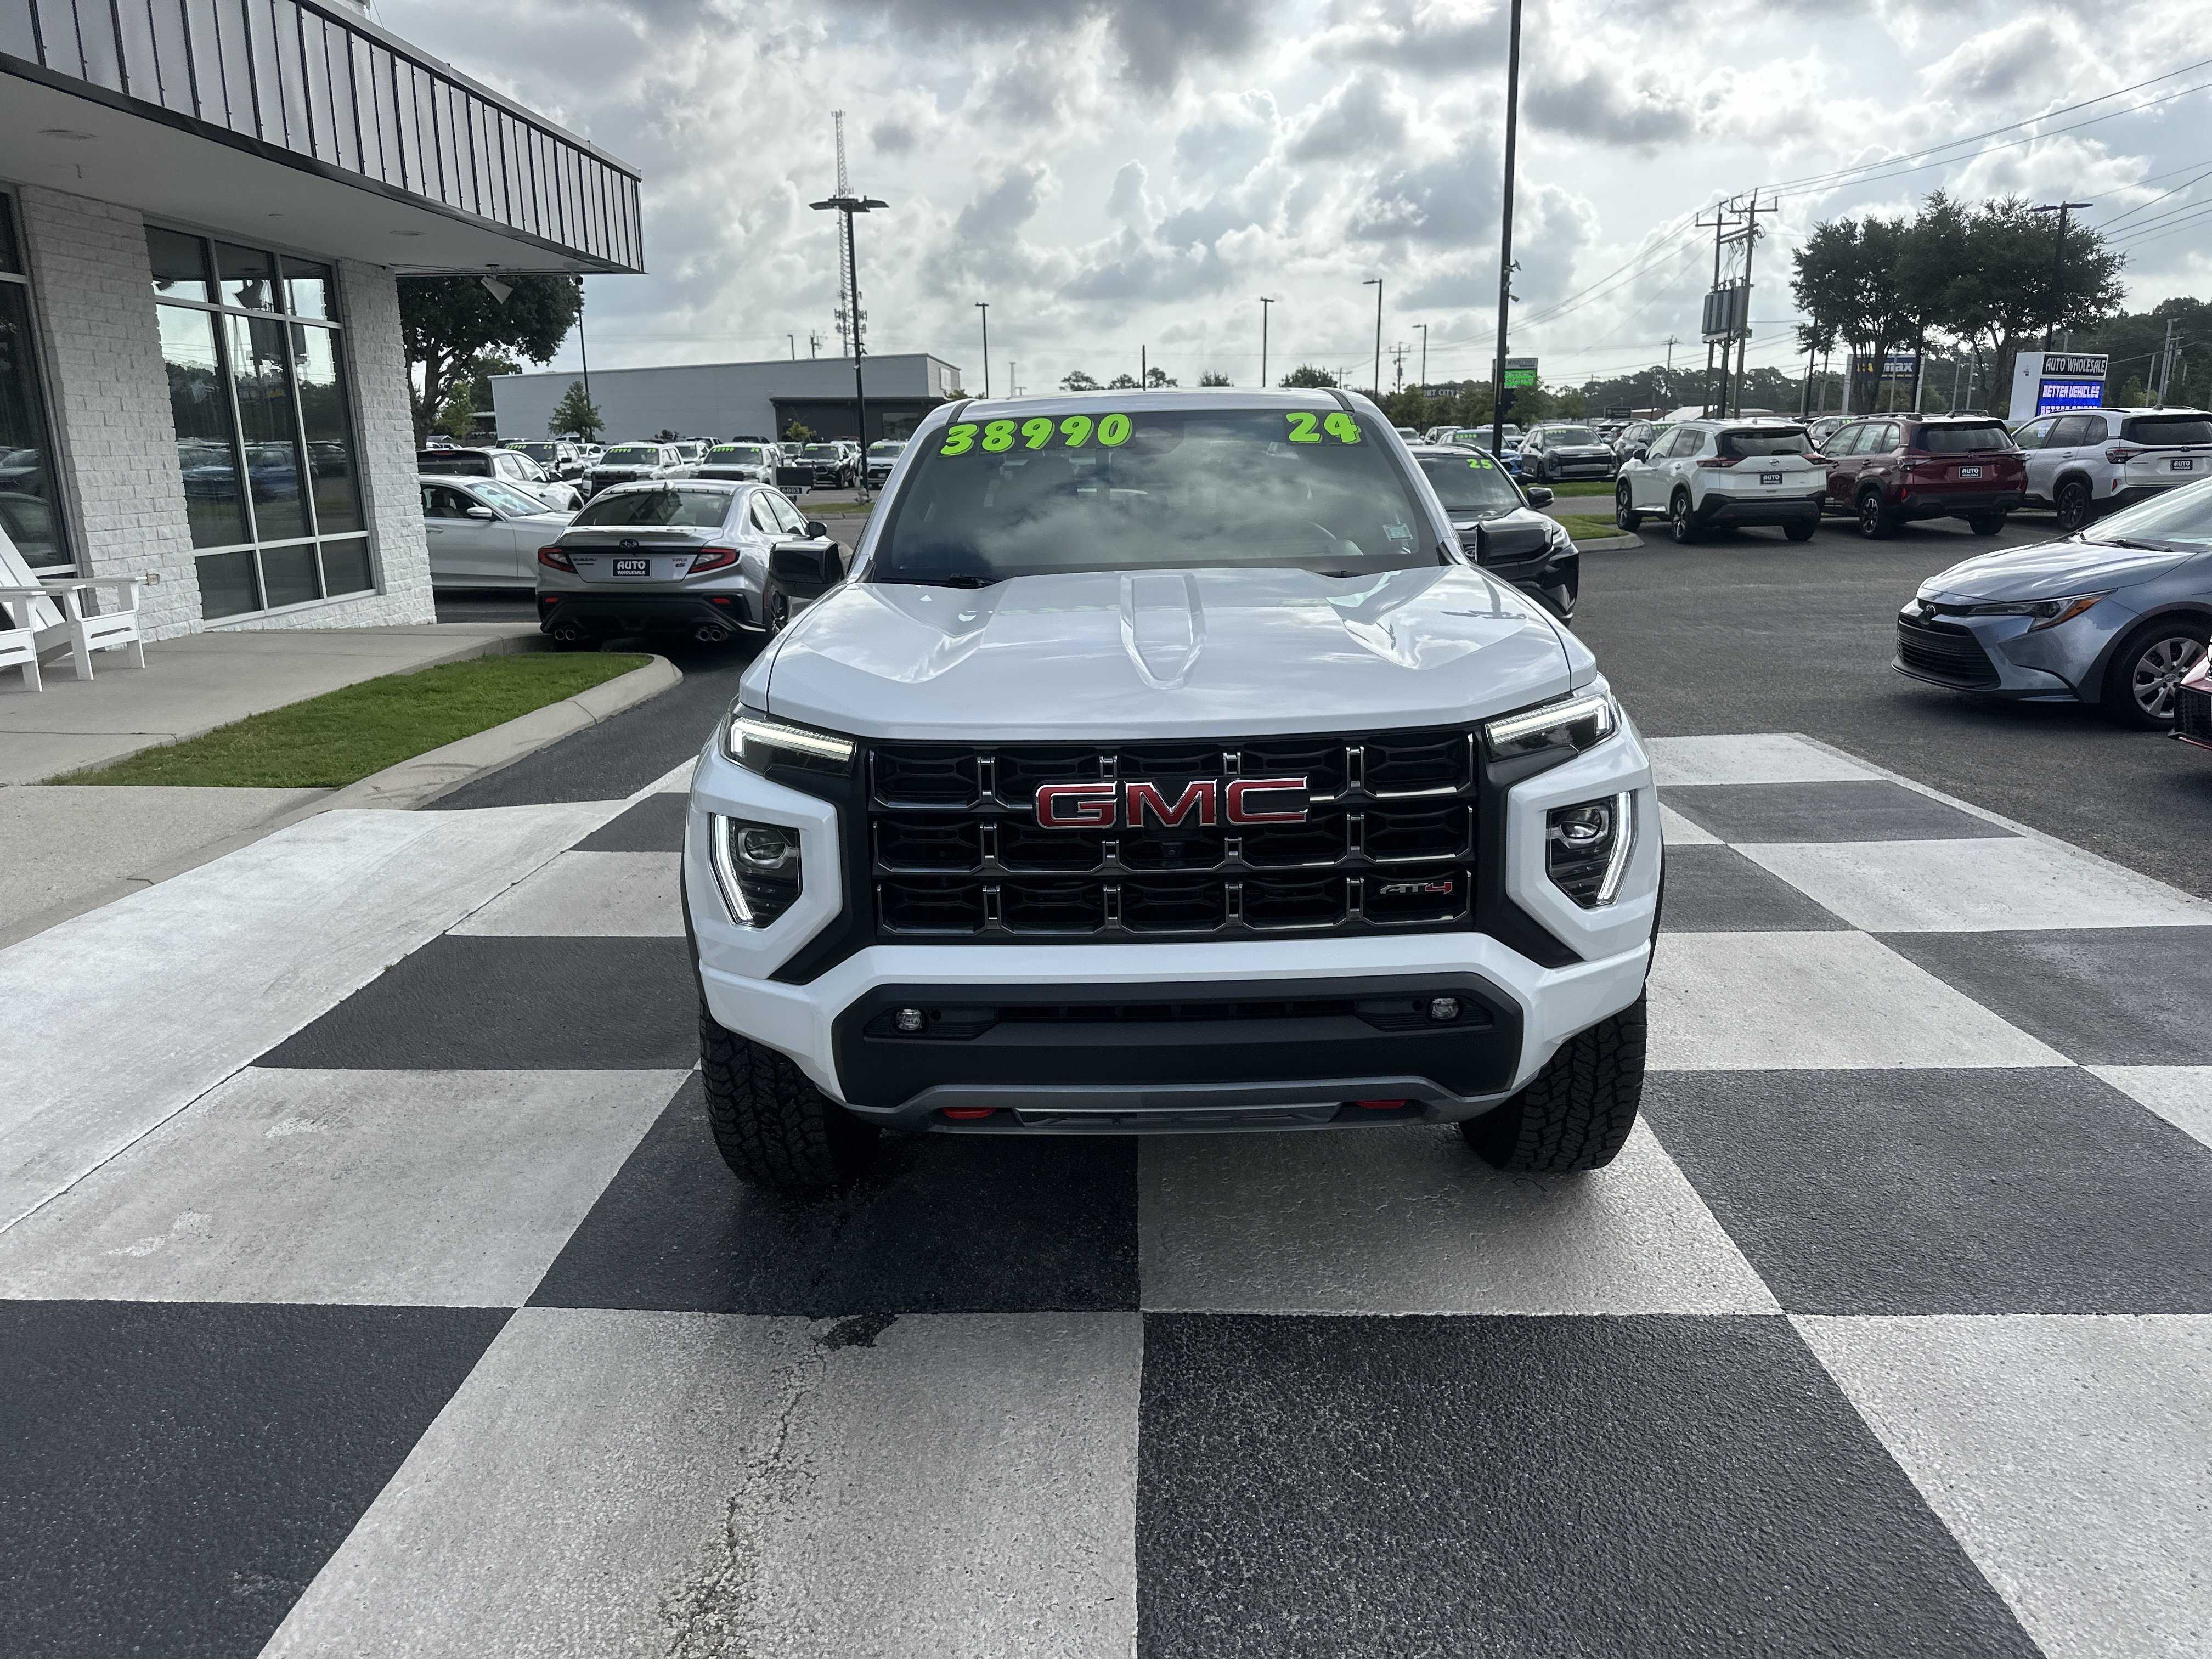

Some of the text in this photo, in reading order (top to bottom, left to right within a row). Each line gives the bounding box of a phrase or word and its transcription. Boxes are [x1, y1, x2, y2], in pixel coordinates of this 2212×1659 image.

[2045, 357, 2066, 372] AUTO
[2067, 358, 2106, 373] WHOLESALE
[2042, 385, 2069, 398] BETTER
[940, 412, 1362, 456] 38990 24
[1466, 459, 1493, 470] 25
[617, 561, 646, 570] AUTO
[1035, 775, 1310, 830] GMC
[1380, 881, 1453, 895] AT4
